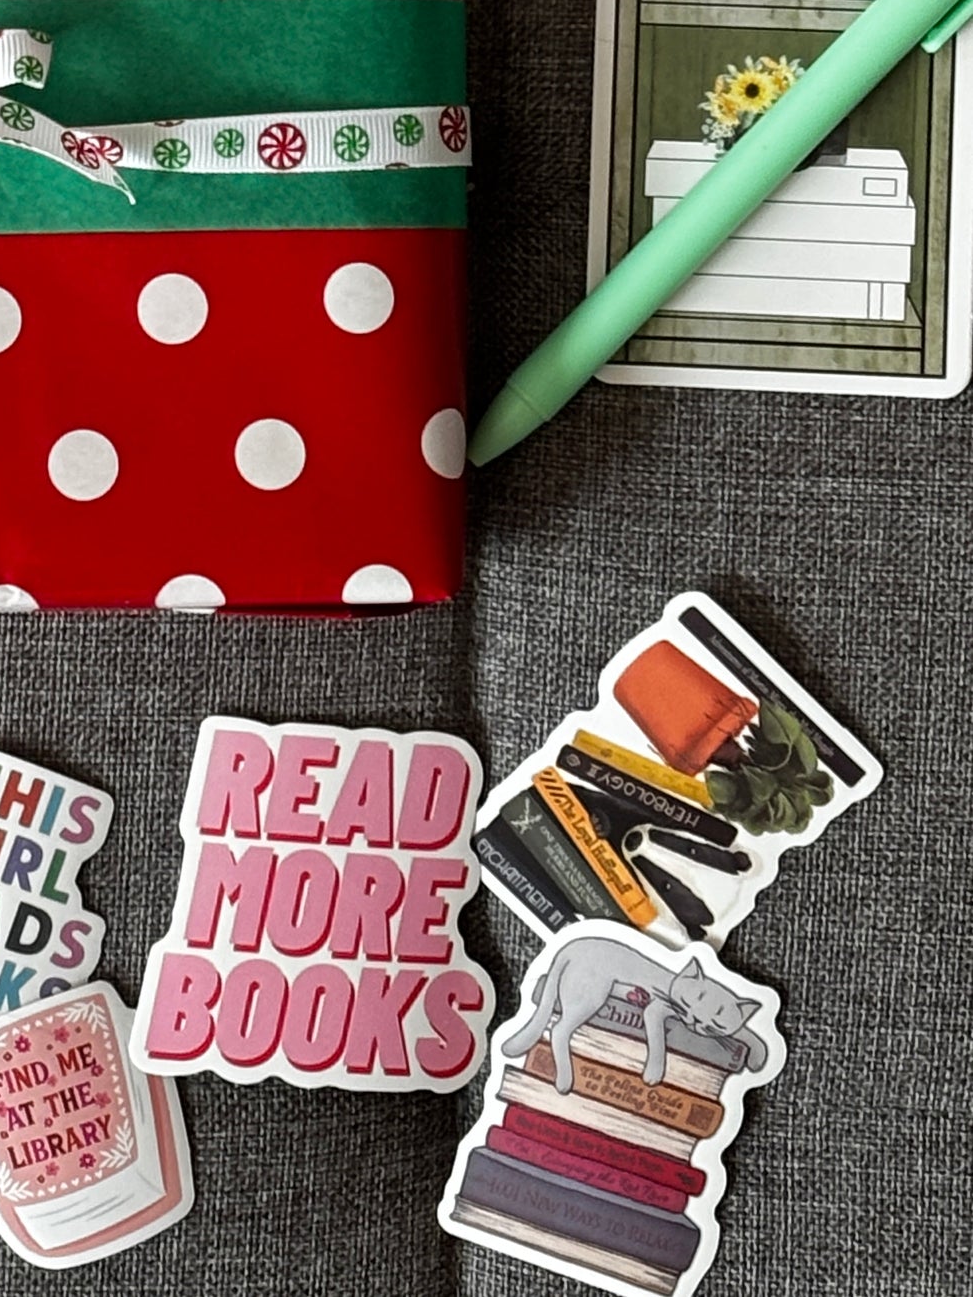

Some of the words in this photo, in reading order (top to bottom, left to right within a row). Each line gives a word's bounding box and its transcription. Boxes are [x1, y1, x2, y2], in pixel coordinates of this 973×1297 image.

[196, 729, 470, 850] READ
[597, 772, 700, 829] HERBOLOGY
[572, 817, 599, 848] Loyal
[184, 842, 468, 964] MORE
[145, 952, 483, 1078] BOOKS
[56, 1042, 97, 1077] ME
[5, 1100, 36, 1133] AT
[43, 1081, 95, 1120] THE
[7, 1114, 113, 1170] LIBRARY
